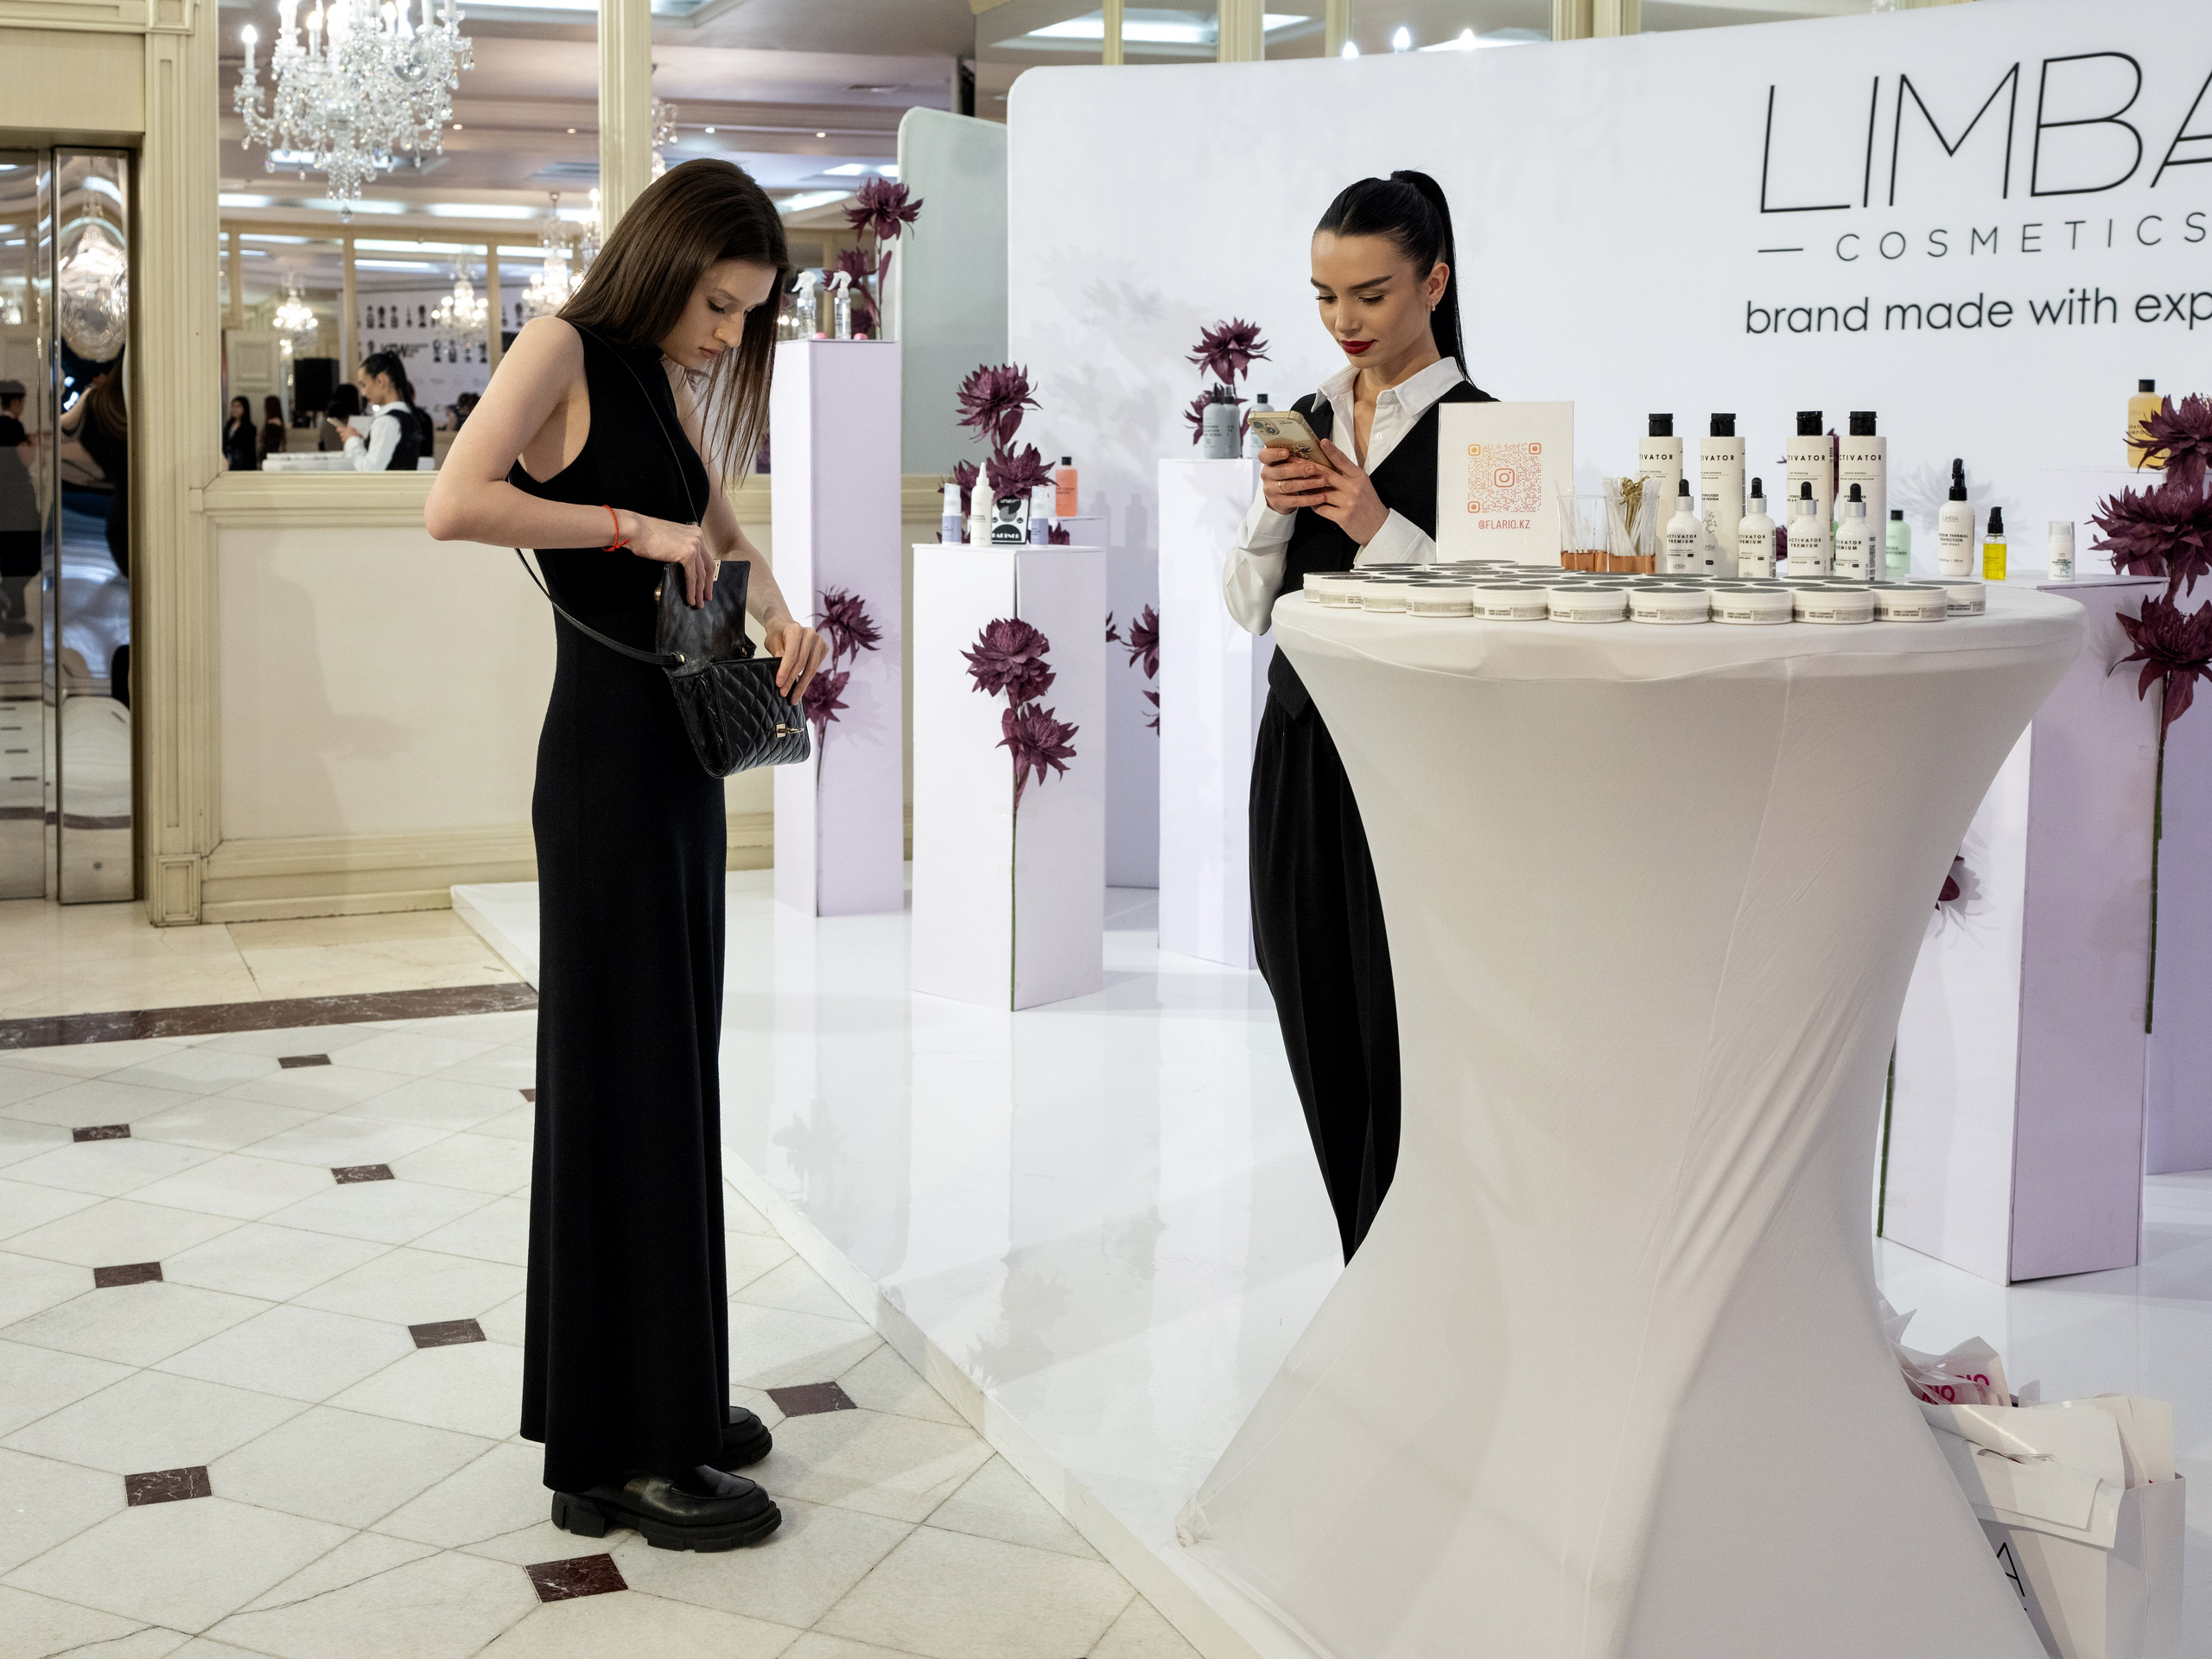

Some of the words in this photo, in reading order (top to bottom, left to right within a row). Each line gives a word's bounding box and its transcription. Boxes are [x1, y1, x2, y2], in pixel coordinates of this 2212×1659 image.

[1836, 212, 2207, 262] COSMETICS
[1746, 296, 1869, 334] brand
[1885, 291, 2013, 331] made
[2029, 287, 2118, 326] with
[1478, 519, 1531, 530] @FLARIO.KZ
